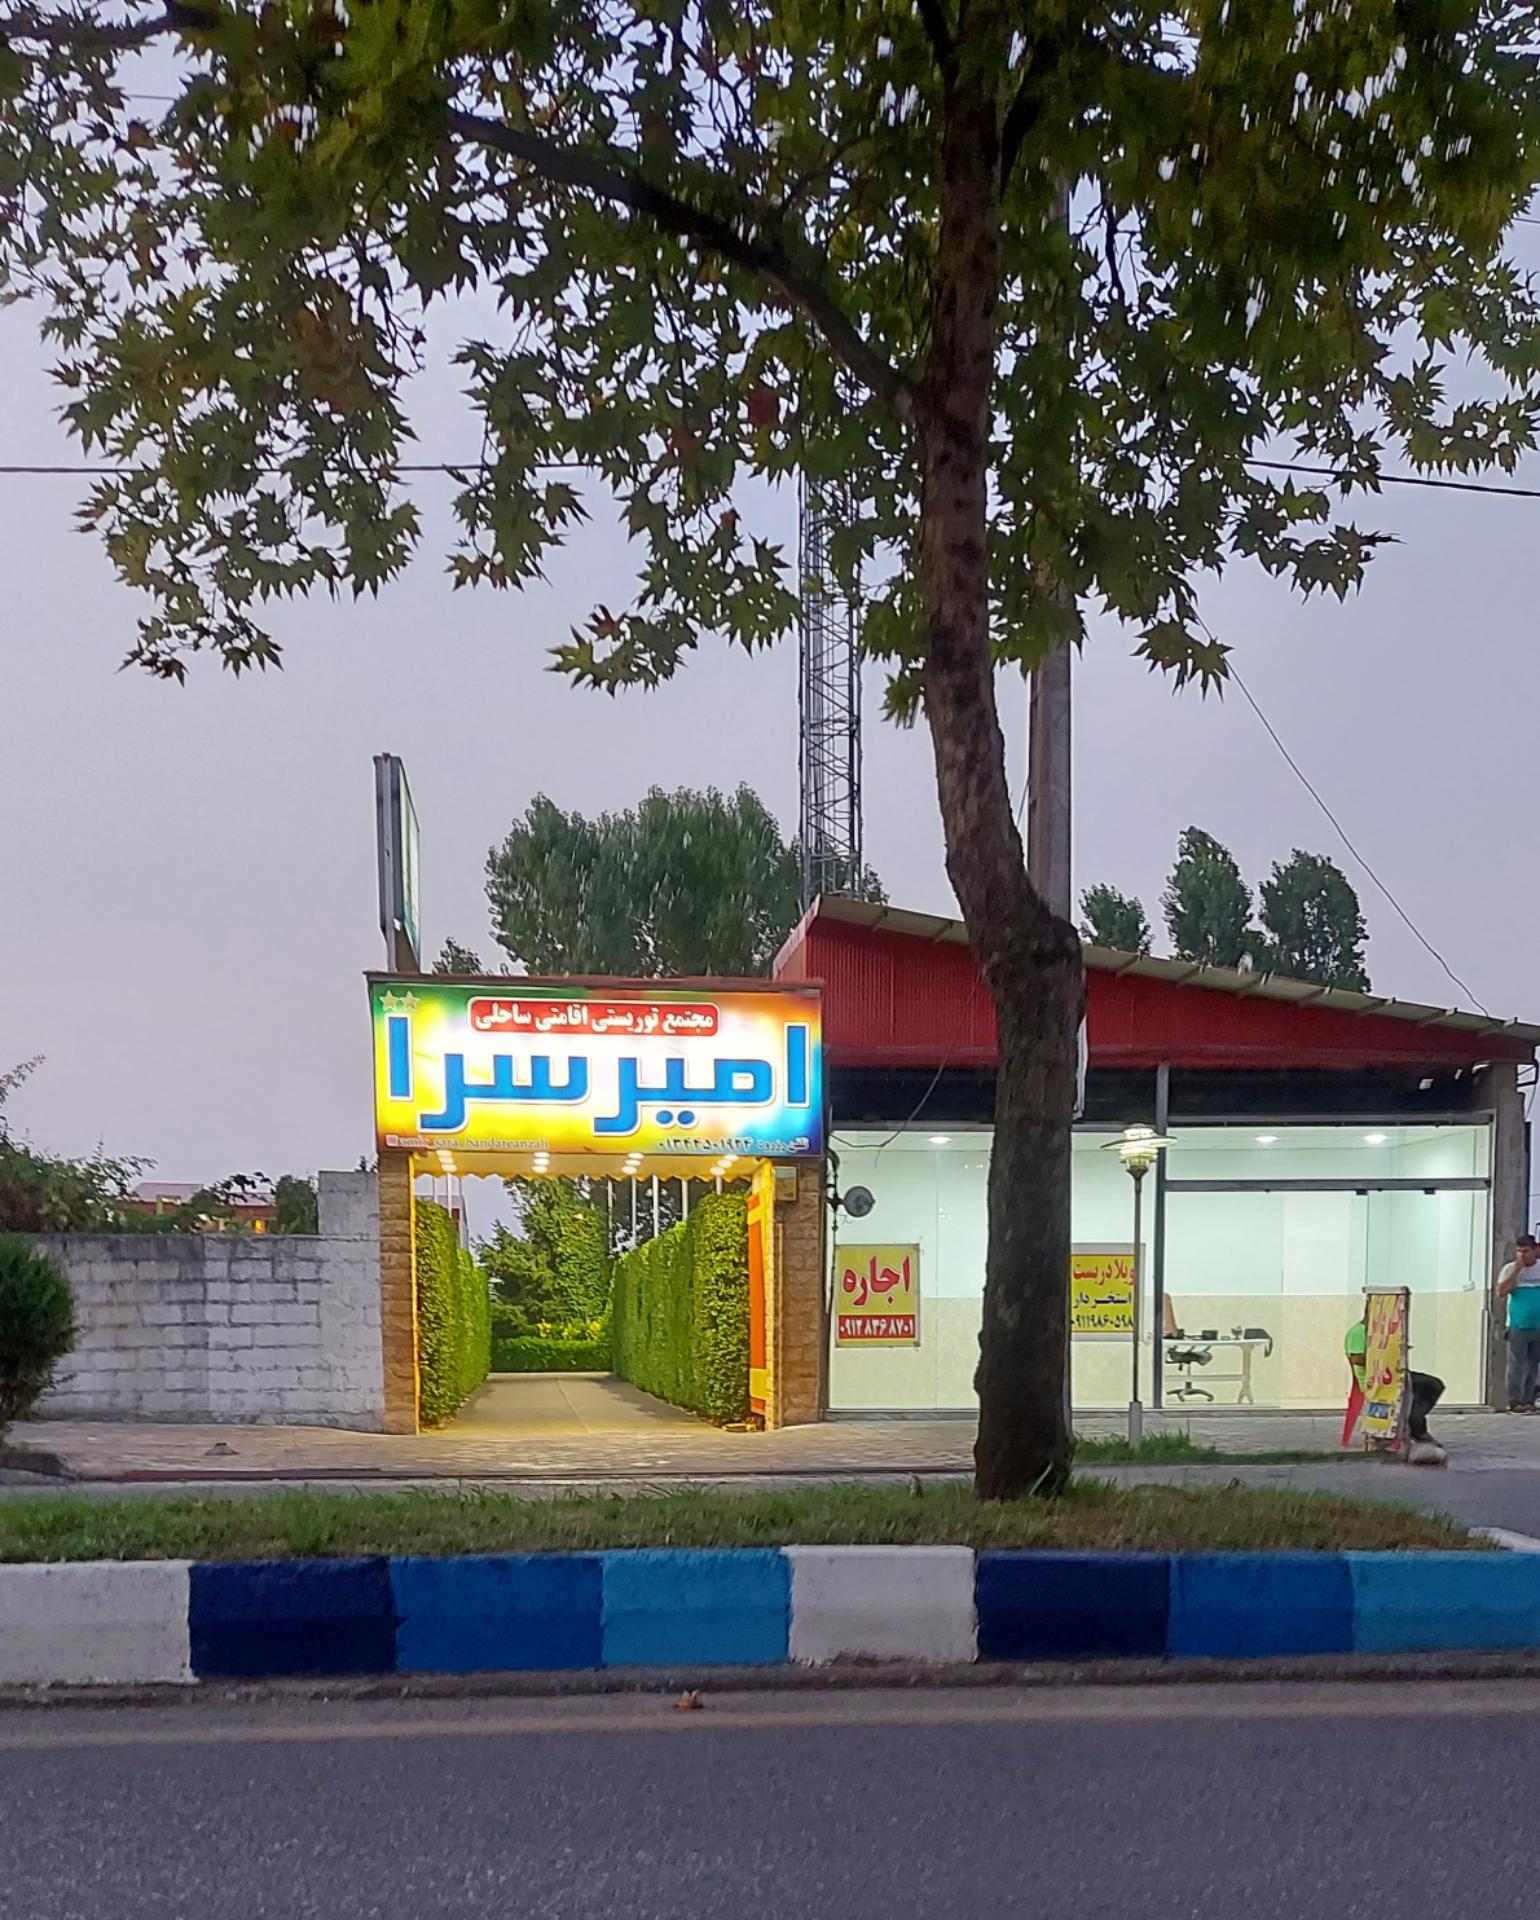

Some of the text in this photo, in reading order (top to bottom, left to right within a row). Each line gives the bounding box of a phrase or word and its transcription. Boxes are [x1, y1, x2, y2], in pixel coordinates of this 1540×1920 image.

[475, 1003, 713, 1033] مجتمع توریستی اقامتی ساحلی
[843, 1255, 911, 1306] اجاره
[1073, 1263, 1112, 1286] دربست
[1073, 1291, 1132, 1309] استخر دار
